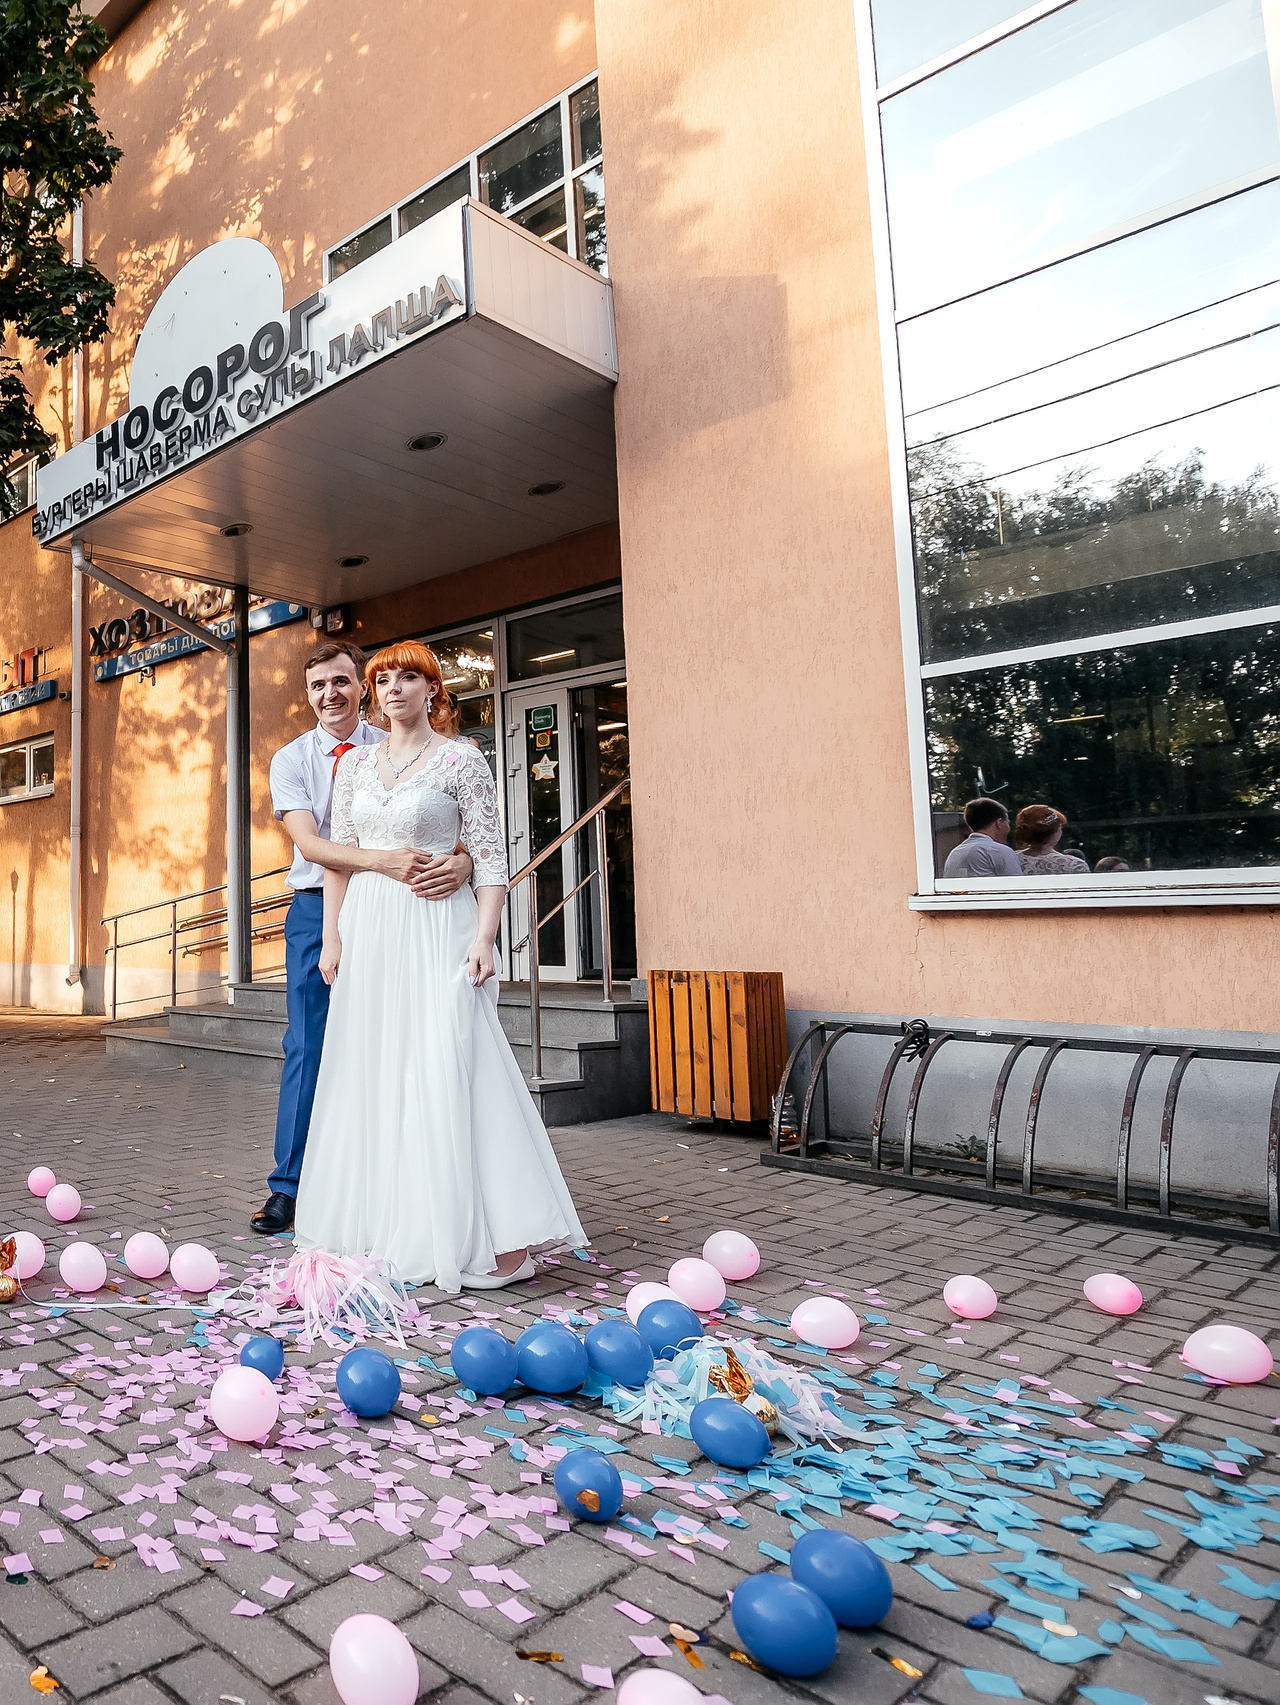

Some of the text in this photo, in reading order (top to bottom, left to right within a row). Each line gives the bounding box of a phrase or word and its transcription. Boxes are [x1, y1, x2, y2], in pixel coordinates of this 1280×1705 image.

[32, 274, 462, 538] БУРГЕРЫ ШАВЕРМА СУПЫ ЛАПША
[96, 291, 325, 471] НОСОРОГ
[130, 639, 178, 665] ТОВАРЫ
[181, 635, 203, 651] ДЛ
